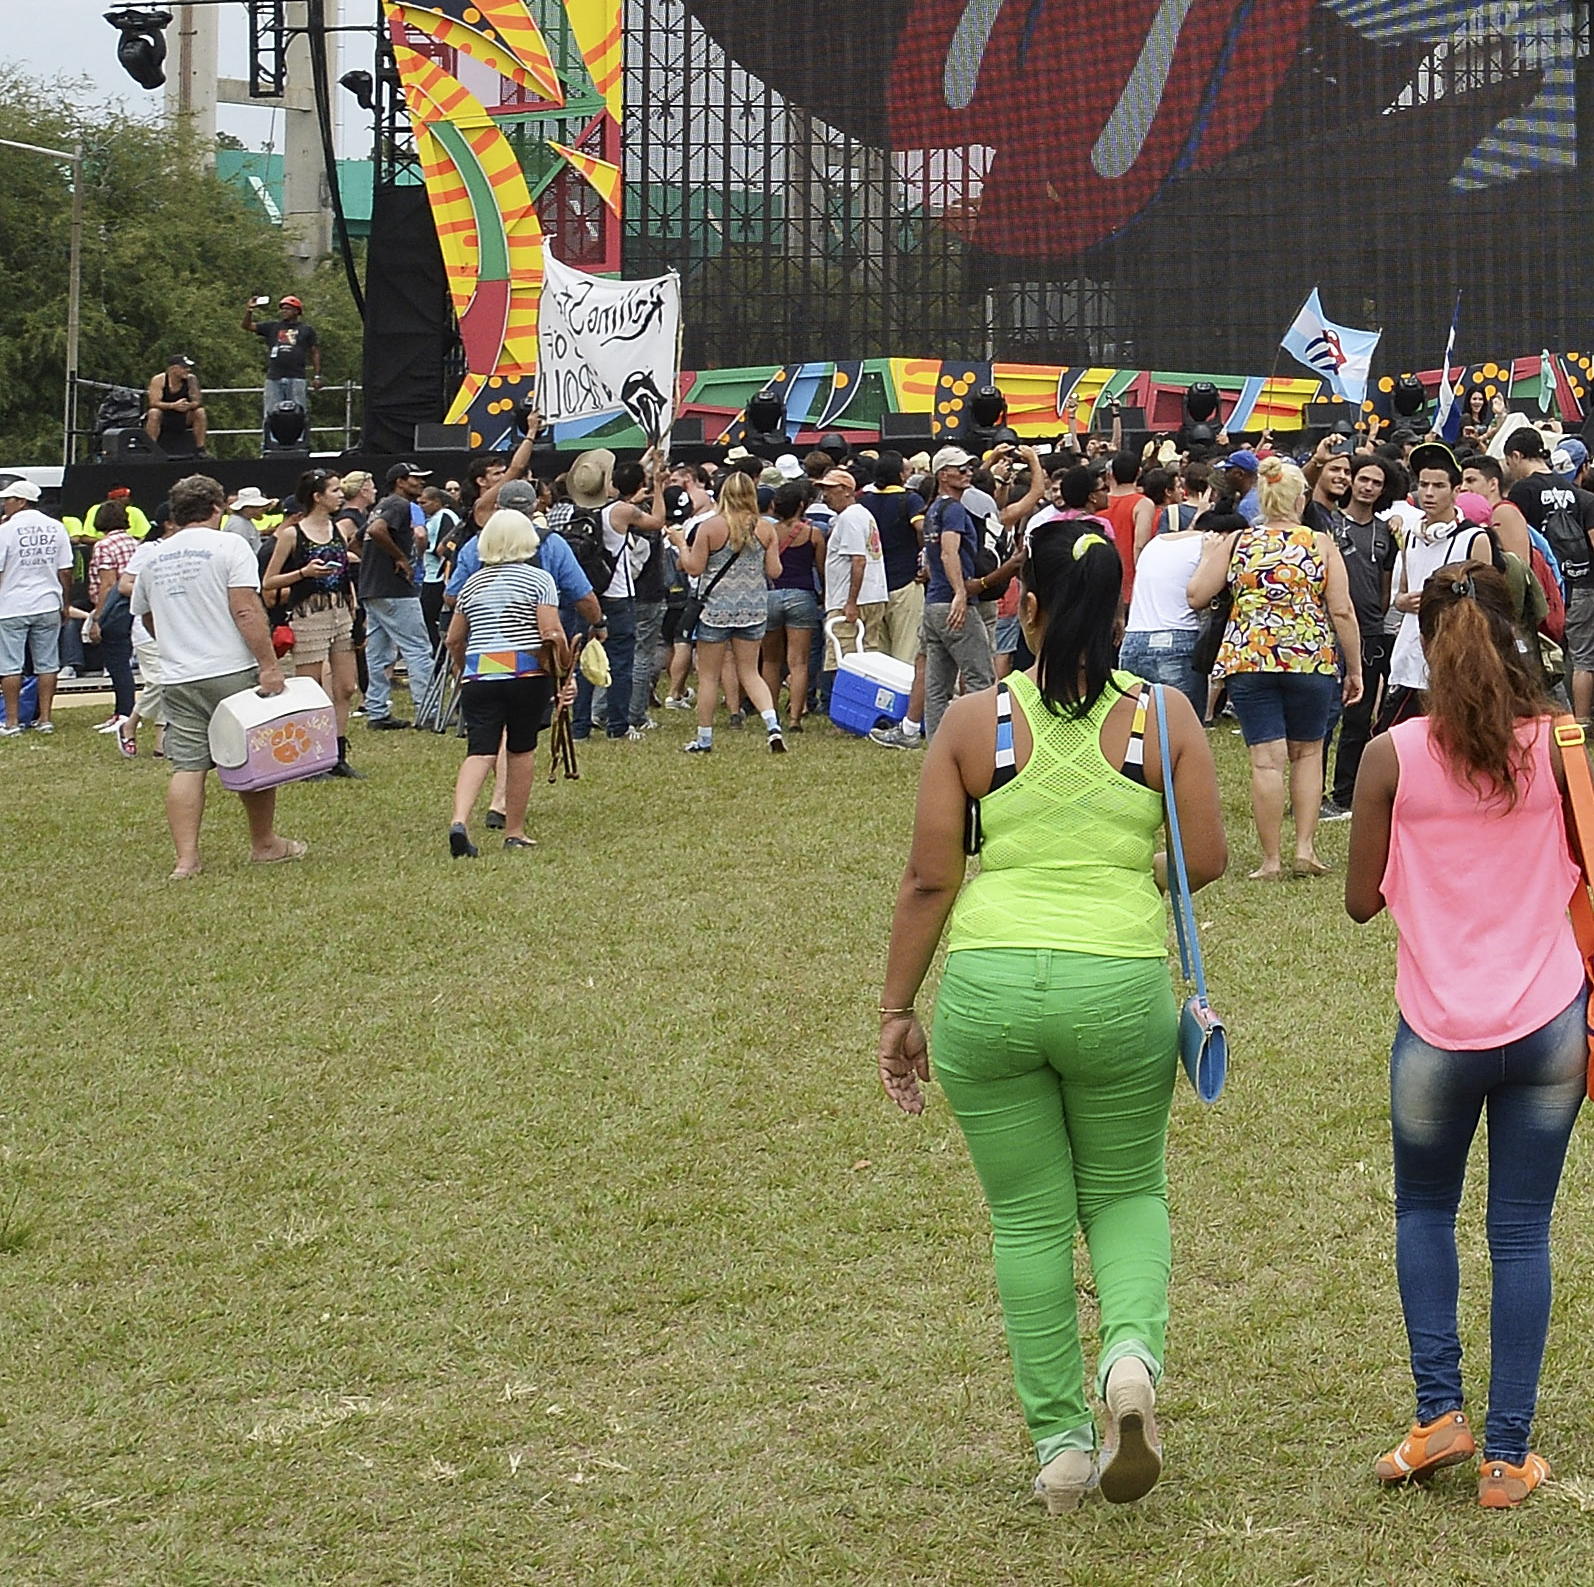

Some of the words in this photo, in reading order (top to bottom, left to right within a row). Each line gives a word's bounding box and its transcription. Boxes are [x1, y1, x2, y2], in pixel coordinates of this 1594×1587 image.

[17, 526, 44, 535] ESTA
[46, 525, 57, 533] ES
[19, 534, 56, 547] CUBA
[20, 547, 43, 558] ESTA
[45, 546, 57, 555] ES
